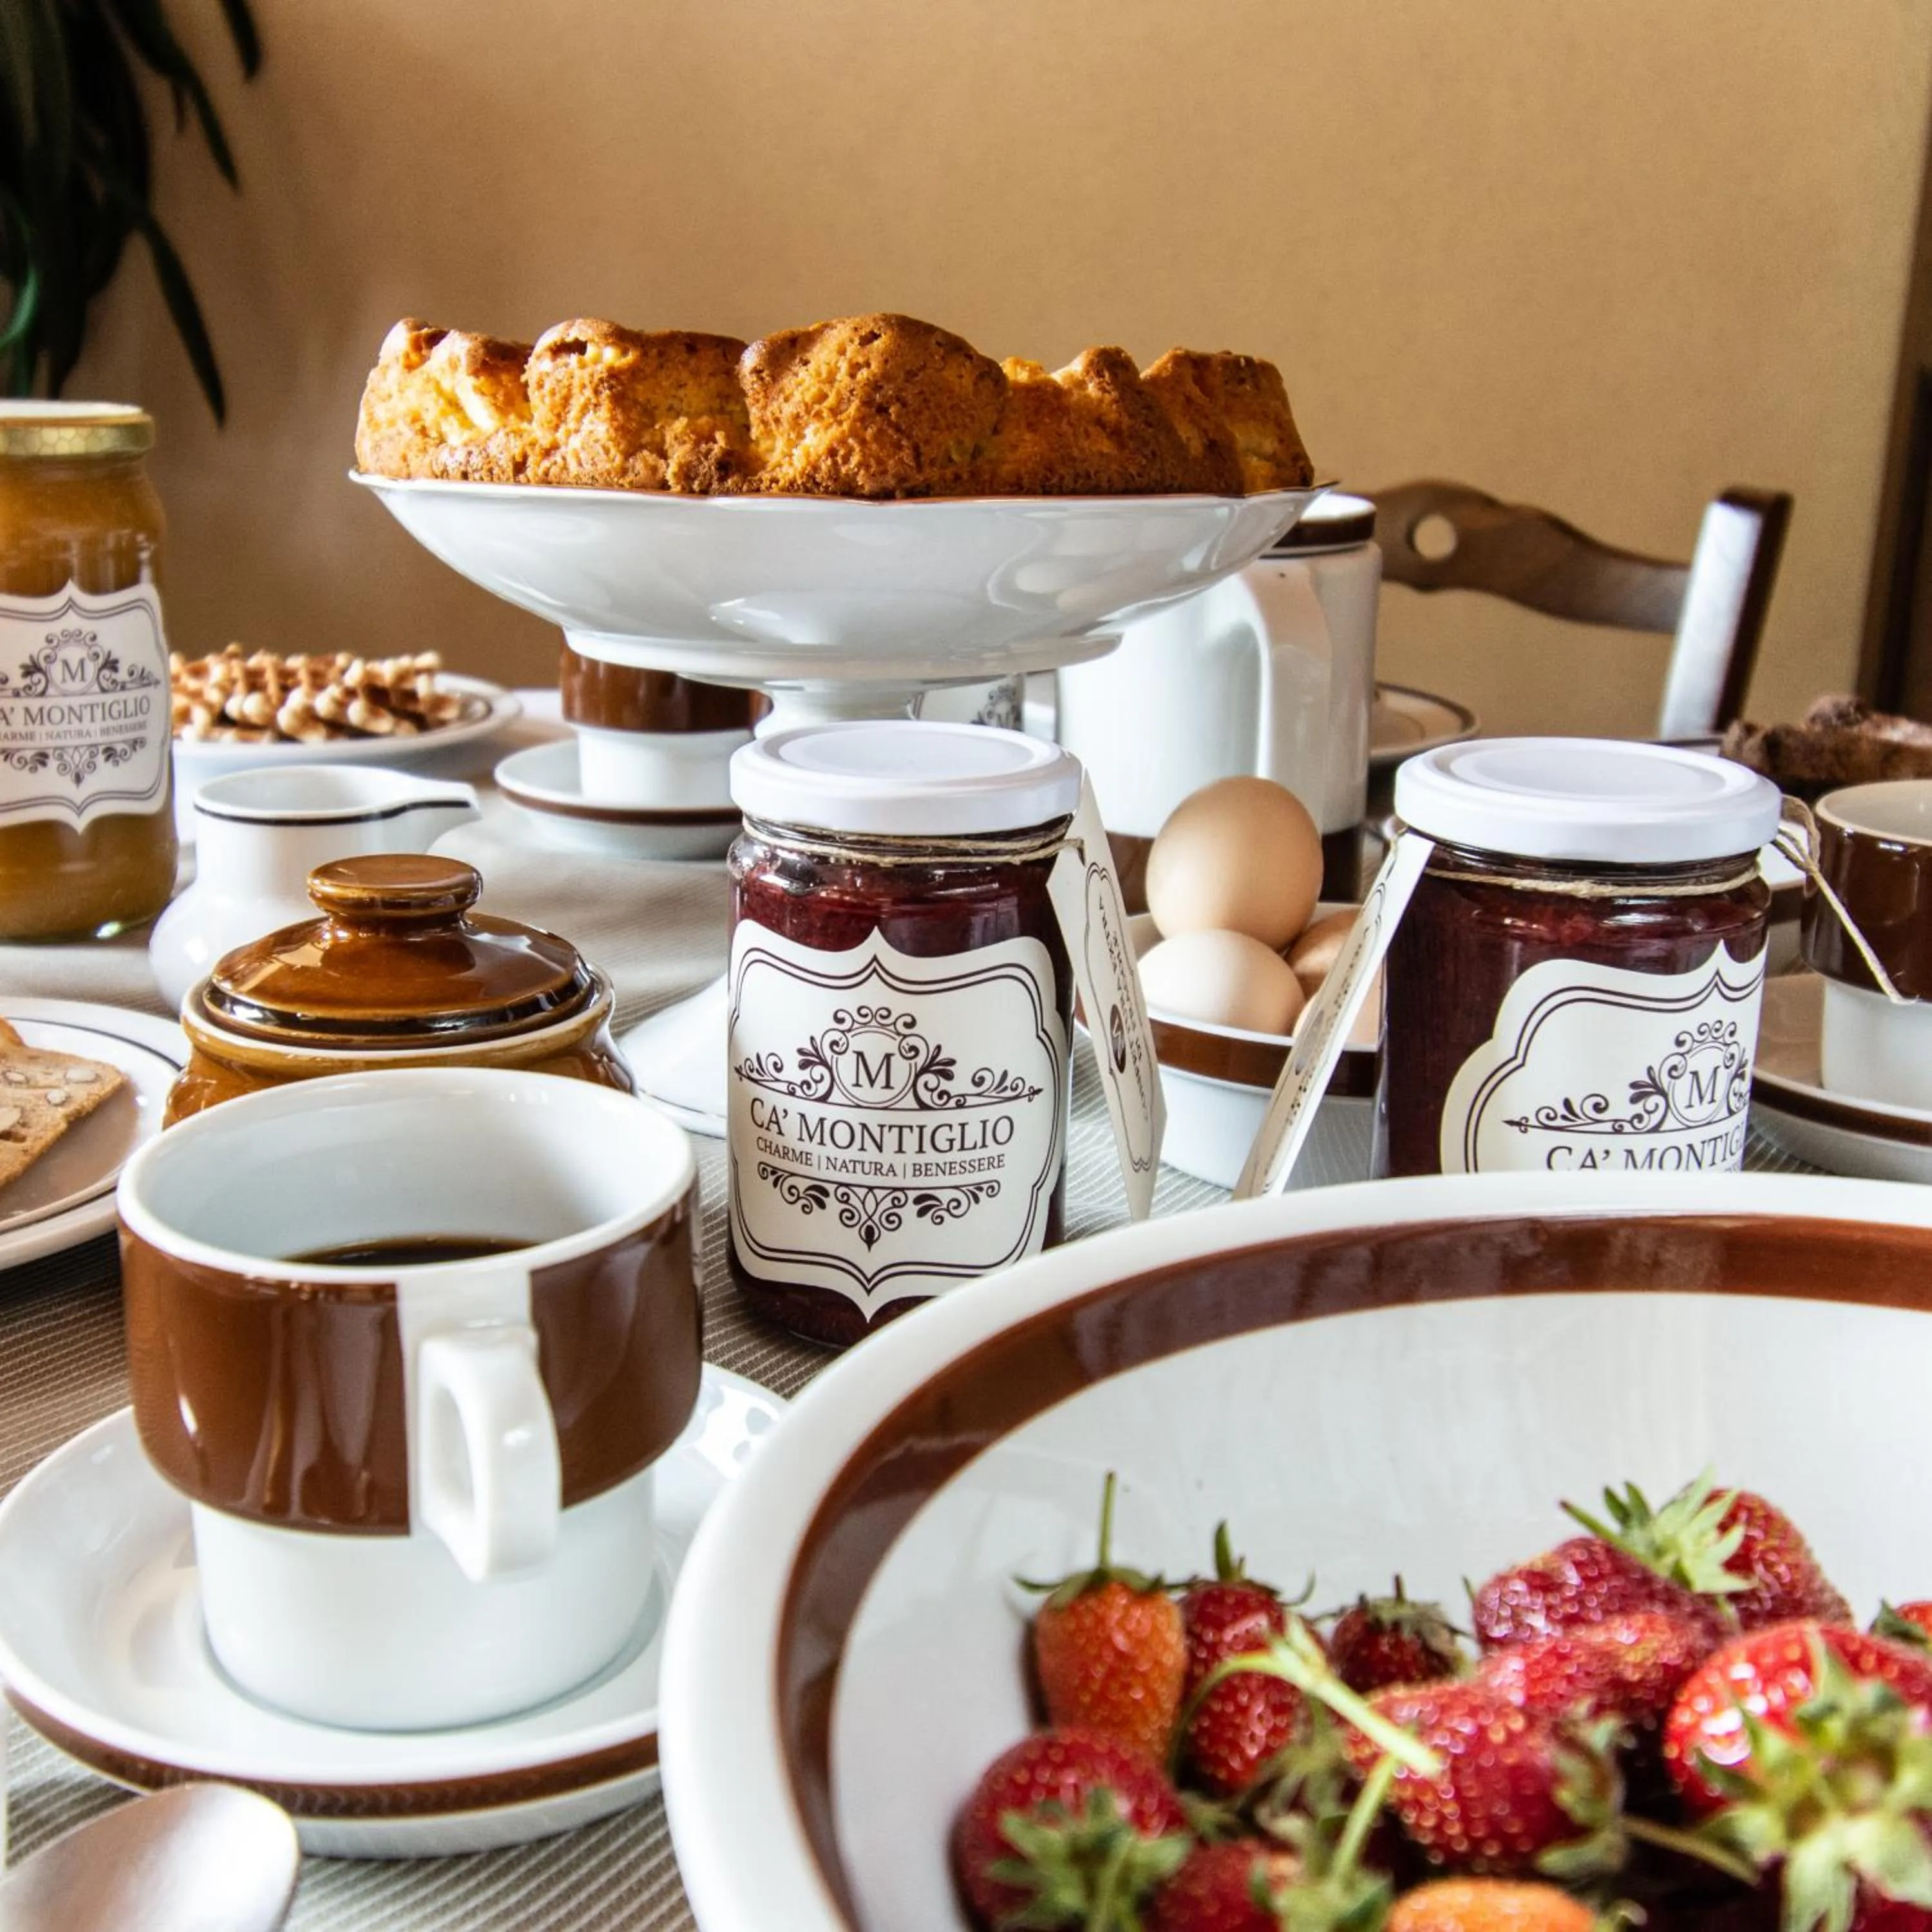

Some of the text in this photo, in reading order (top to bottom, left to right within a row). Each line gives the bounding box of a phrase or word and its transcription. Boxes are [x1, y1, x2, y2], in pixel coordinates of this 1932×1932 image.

[60, 657, 86, 684] M
[0, 695, 151, 726] A' MONTIGLIO
[0, 730, 36, 742] ARME
[45, 729, 93, 741] NATURA
[851, 1050, 896, 1090] M
[1684, 1065, 1721, 1110] M
[750, 1097, 1016, 1155] CA' MONTIGLIO
[756, 1136, 813, 1167] CHARME
[826, 1155, 898, 1178] NATURA
[912, 1153, 1006, 1179] BENESSERE
[1623, 1124, 1741, 1171] MONTIG
